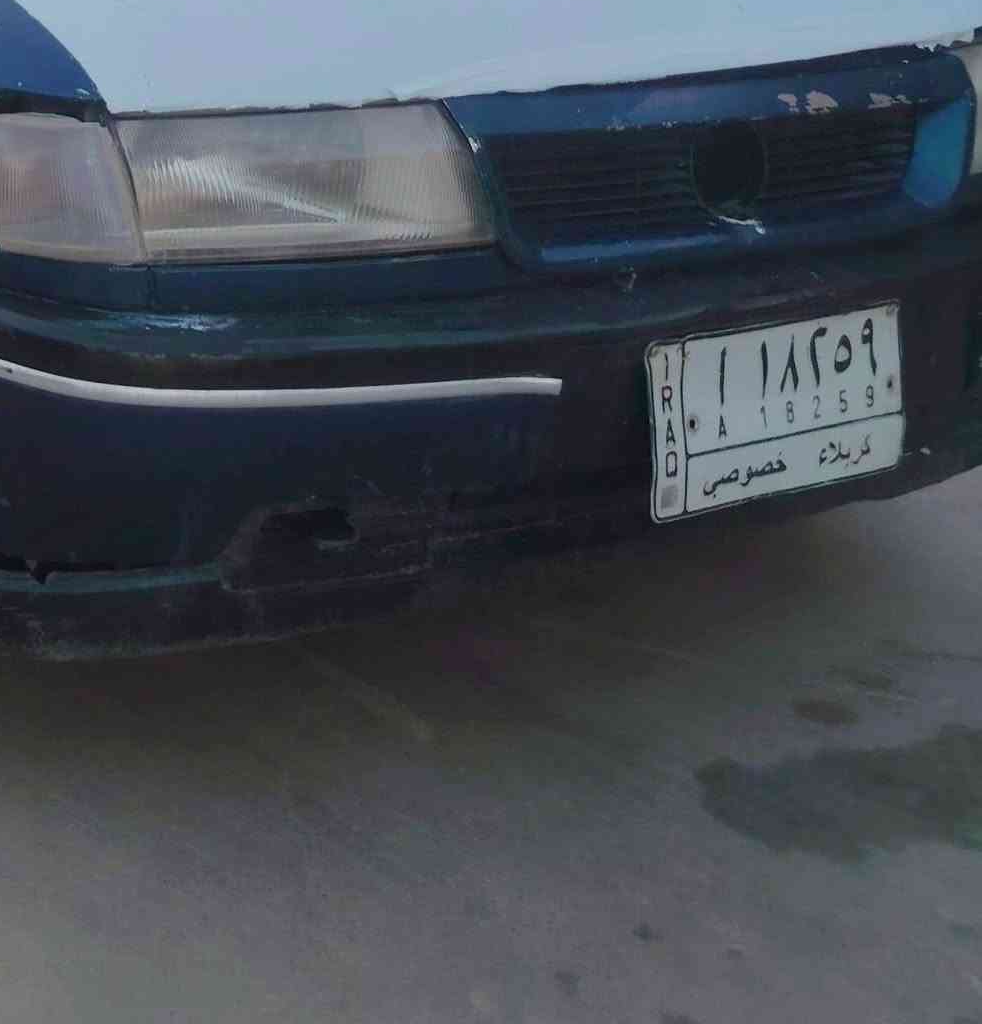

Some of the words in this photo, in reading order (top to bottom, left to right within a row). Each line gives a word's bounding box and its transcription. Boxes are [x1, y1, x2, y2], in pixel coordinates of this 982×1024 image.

[660, 352, 679, 479] IRAQ
[718, 414, 728, 440] A
[760, 383, 875, 429] 18259
[702, 450, 788, 499] خصوصي
[818, 433, 872, 469] كربلاء
